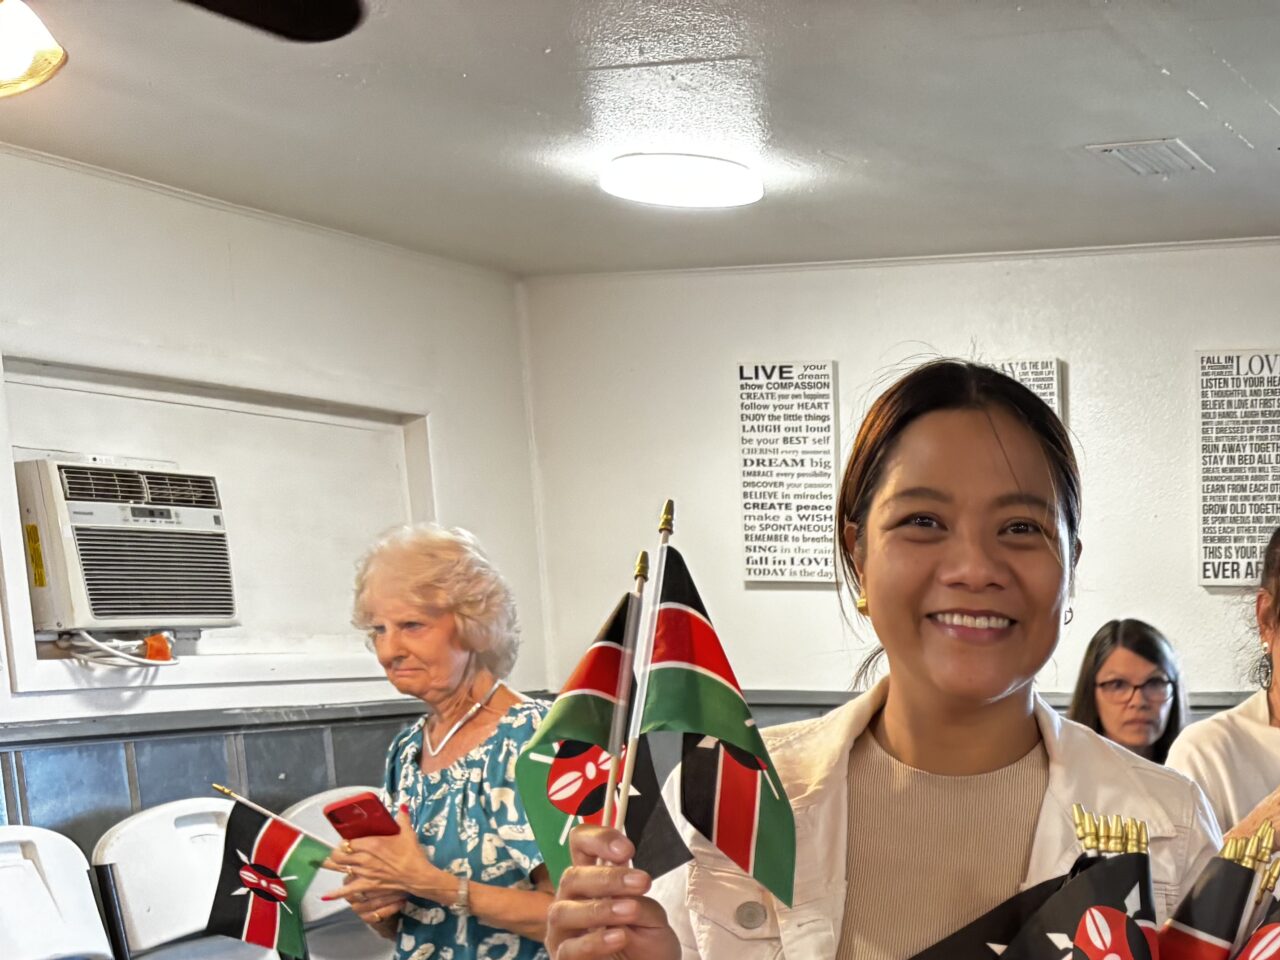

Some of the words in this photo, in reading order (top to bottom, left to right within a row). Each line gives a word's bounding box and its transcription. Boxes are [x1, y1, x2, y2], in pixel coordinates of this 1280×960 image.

[1201, 355, 1222, 365] FALL
[1225, 355, 1234, 364] IN
[1029, 361, 1039, 370] THE
[739, 365, 794, 380] LIVE
[740, 382, 763, 390] show
[766, 382, 830, 390] COMPASSION
[1201, 378, 1229, 389] LISTEN
[1231, 378, 1241, 388] TO
[1243, 377, 1265, 387] YOUR
[740, 392, 777, 400] CREATE
[1201, 390, 1209, 398] BE
[1210, 389, 1248, 398] THOUGHTFUL
[1249, 389, 1262, 397] AND
[740, 402, 769, 410] follow
[797, 402, 829, 410] HEART
[1201, 400, 1225, 410] BELIEVE
[1226, 400, 1233, 409] IN
[1234, 399, 1249, 409] LOVE
[1250, 399, 1258, 408] AT
[1259, 398, 1275, 408] FIRST
[741, 414, 766, 422] ENJOY
[804, 414, 830, 423] things
[1201, 411, 1217, 419] HOLD
[1240, 410, 1260, 418] LAUGH
[742, 425, 780, 433] LAUGH
[741, 436, 753, 444] be
[756, 438, 779, 446] your
[782, 436, 808, 444] BEST
[812, 436, 830, 444] self
[1201, 444, 1220, 454] RUN
[1221, 443, 1247, 453] AWAY
[743, 458, 805, 467] DREAM
[810, 458, 831, 469] big
[1201, 455, 1225, 466] STAY
[1227, 455, 1236, 464] IN
[1238, 454, 1255, 464] BED
[1257, 454, 1274, 464] ALL
[1202, 484, 1226, 494] LEARN
[1227, 484, 1248, 493] FROM
[1249, 483, 1269, 493] EACH
[743, 491, 778, 499] BELIEVE
[744, 502, 792, 510] CREATE
[796, 504, 832, 512] peace
[1202, 504, 1229, 515] GROW
[1230, 503, 1247, 514] OLD
[744, 513, 780, 521] make
[797, 514, 833, 522] WISH
[1202, 516, 1209, 525] BE
[1210, 516, 1251, 525] SPONTANEOUS
[1252, 516, 1263, 524] AND
[744, 523, 756, 531] be
[759, 524, 833, 532] SPONTANEOUS
[1218, 526, 1235, 534] EACH
[1236, 526, 1257, 534] OTHER
[745, 534, 789, 542] REMEMBER
[802, 534, 833, 543] breathe
[1202, 536, 1232, 544] REMEMBER
[745, 545, 777, 553] SING
[1202, 546, 1222, 559] THIS
[1224, 546, 1233, 559] IS
[1234, 546, 1258, 559] YOUR
[746, 556, 768, 565] fall
[772, 556, 786, 565] in
[746, 568, 787, 576] TODAY
[790, 569, 797, 577] is
[800, 569, 815, 577] the
[817, 570, 833, 579] day
[1202, 562, 1240, 579] EVER
